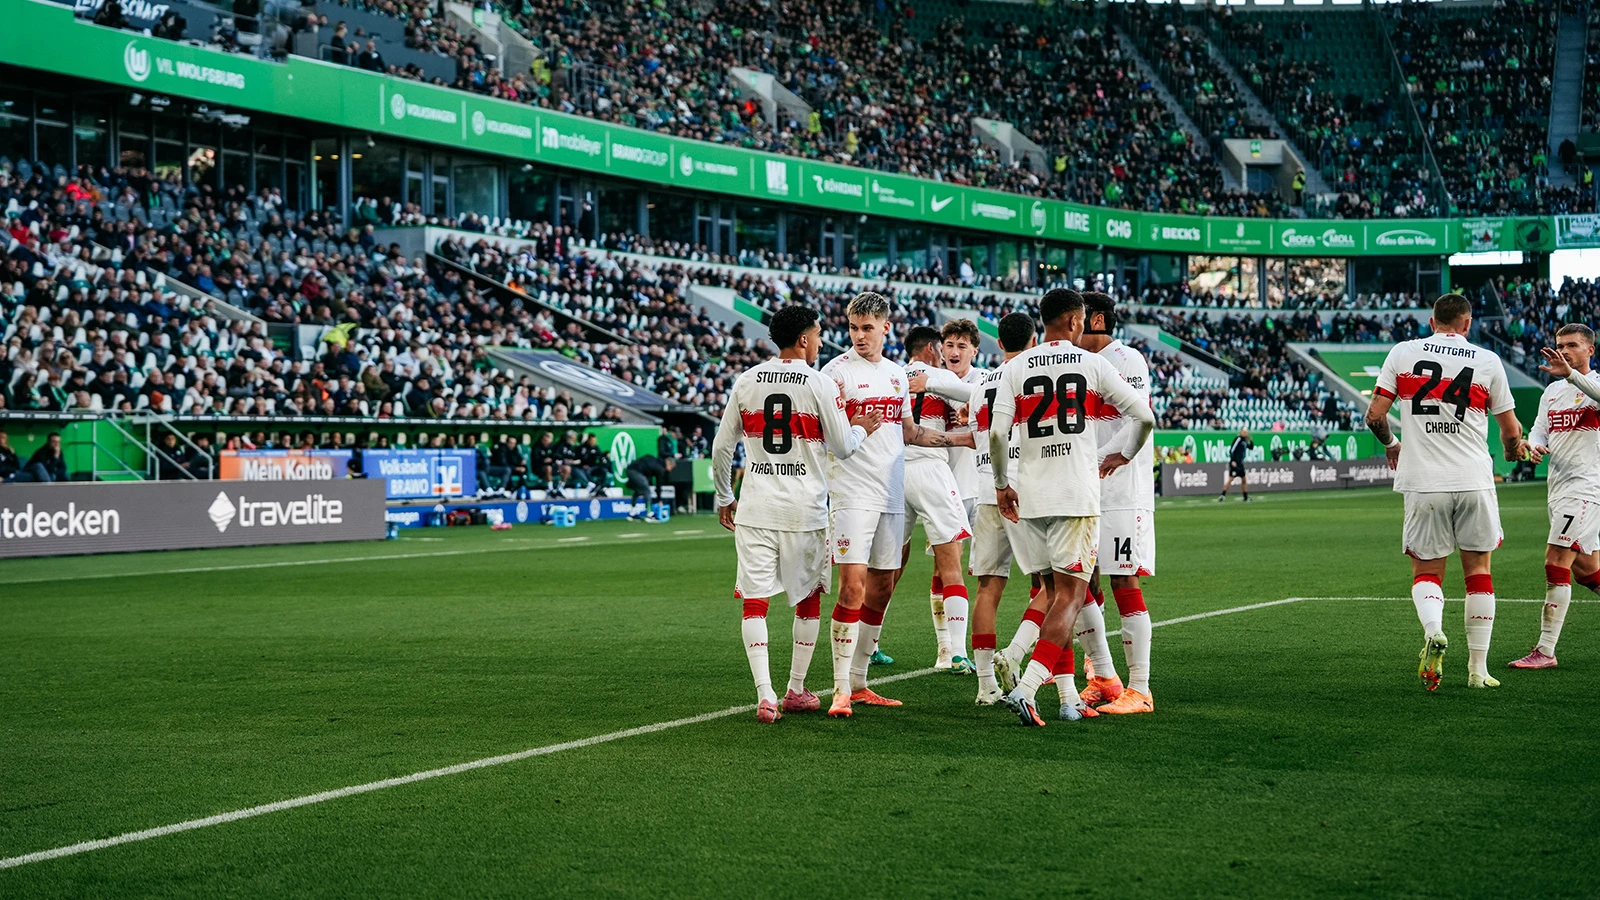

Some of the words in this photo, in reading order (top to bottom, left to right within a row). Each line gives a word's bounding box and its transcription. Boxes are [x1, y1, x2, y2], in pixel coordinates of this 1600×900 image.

[177, 61, 245, 89] WOLFSBURG
[1064, 211, 1090, 233] MRE
[1106, 219, 1132, 239] CHG
[1162, 225, 1201, 241] BECK'S
[1028, 353, 1083, 369] STUTTGART
[1423, 343, 1476, 359] STUTTGART
[756, 371, 809, 386] STUTTGART
[1411, 360, 1475, 423] 24
[1023, 373, 1088, 438] 28
[762, 393, 793, 454] 8
[1425, 421, 1461, 434] CHABOT
[1041, 442, 1072, 459] NARTEY
[243, 459, 283, 481] Mein
[284, 458, 332, 481] Konto
[378, 458, 429, 475] Volksbank
[775, 461, 807, 476] TOMÁS
[391, 478, 429, 495] BRAWO
[0, 502, 120, 539] tdecken
[239, 494, 343, 528] travelite
[1561, 514, 1575, 535] 7
[1113, 537, 1132, 561] 14
